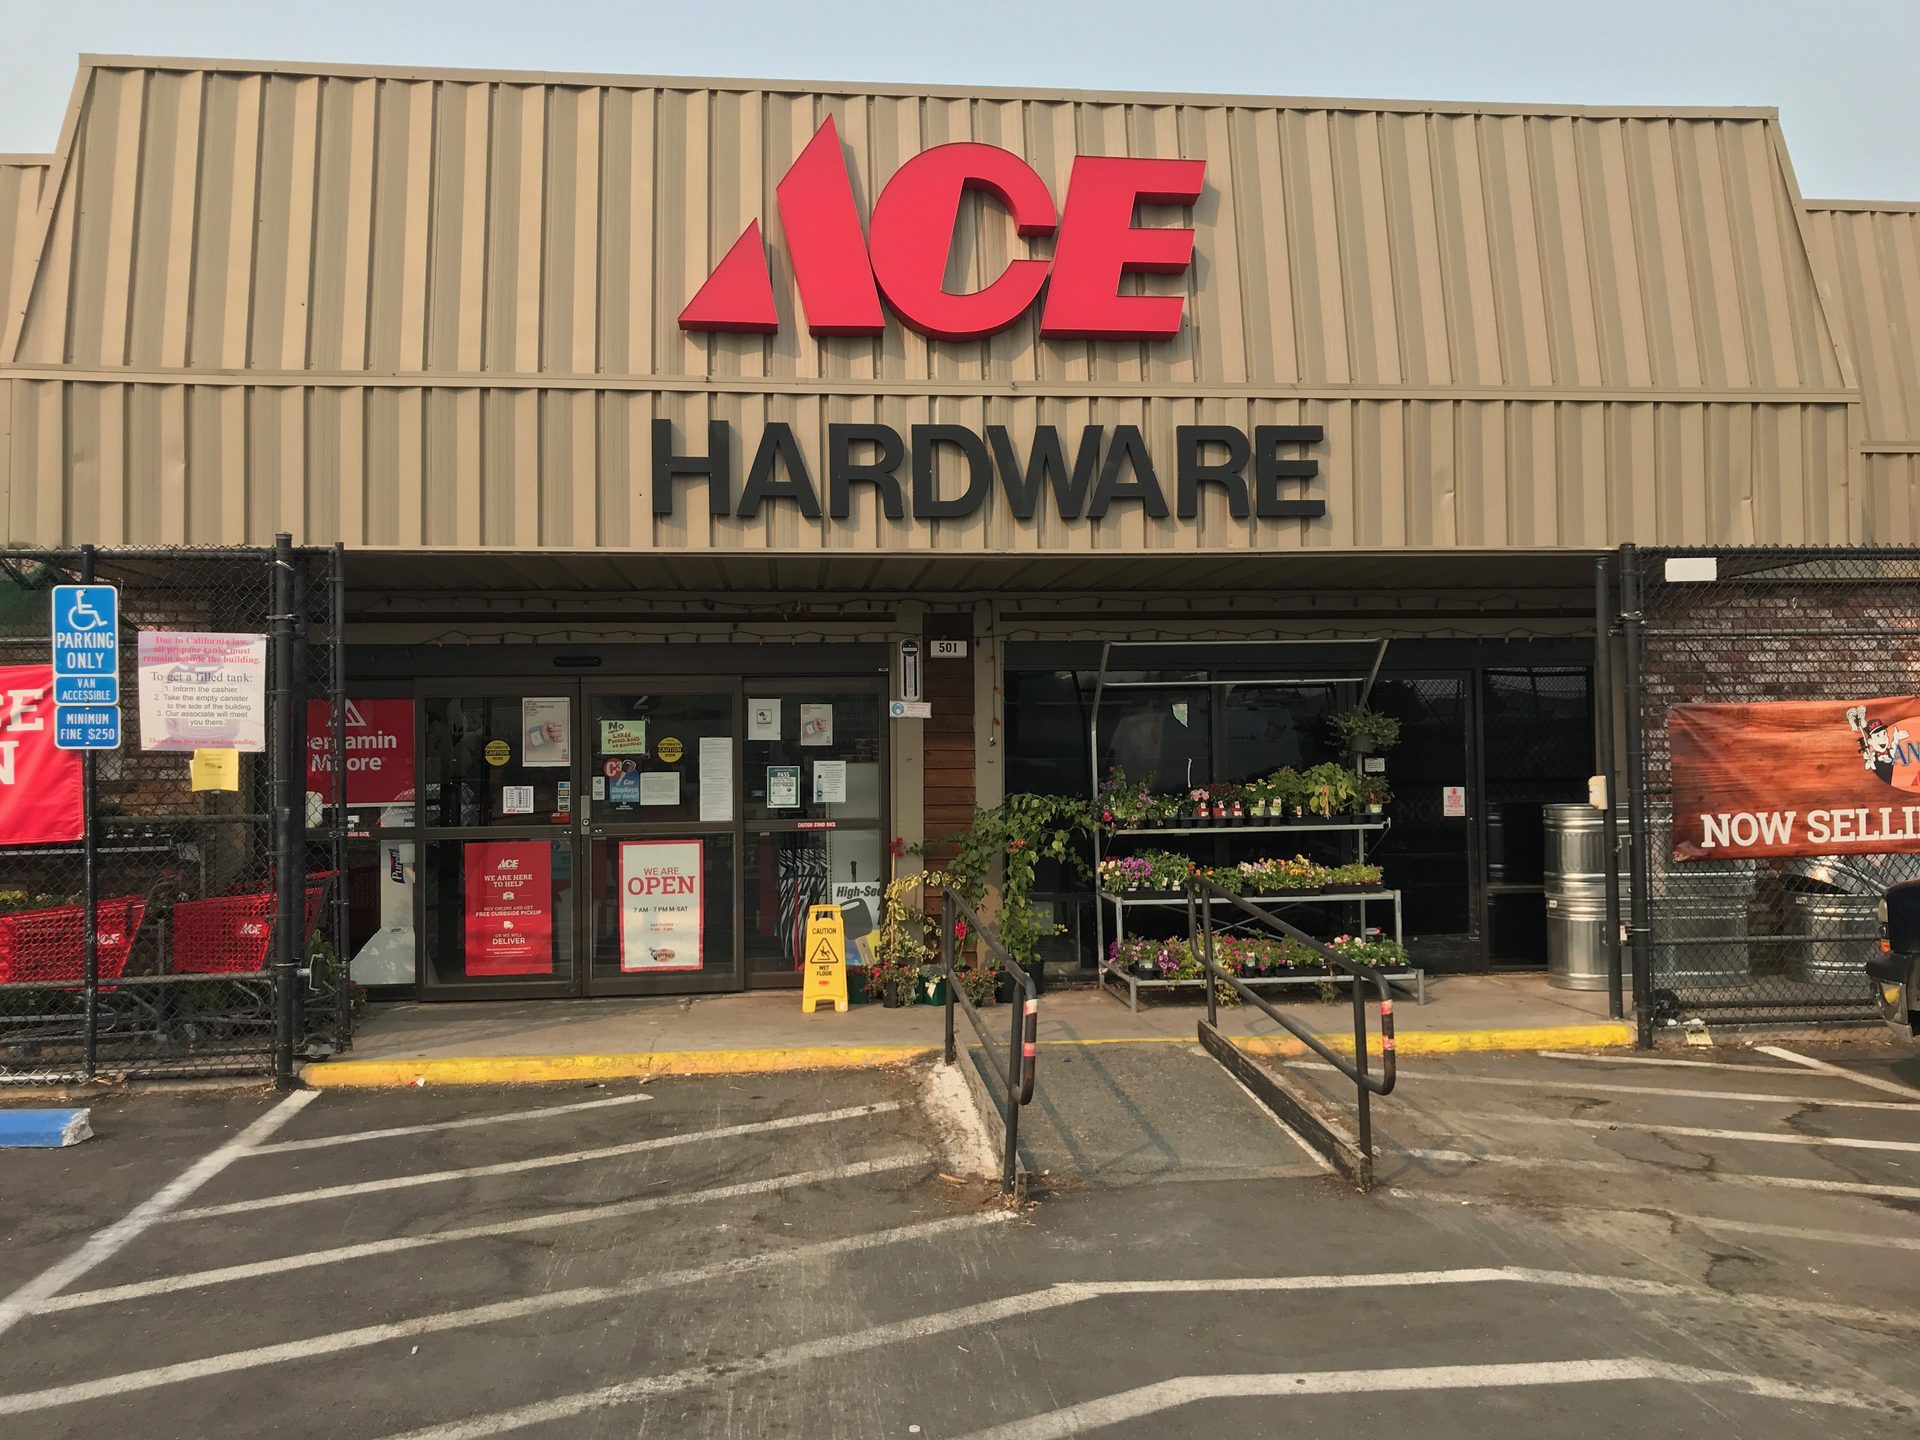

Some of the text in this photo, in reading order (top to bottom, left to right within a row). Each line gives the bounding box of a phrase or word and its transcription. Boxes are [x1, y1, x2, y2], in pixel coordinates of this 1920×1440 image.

[678, 112, 1207, 342] ACE
[651, 418, 1325, 519] HARDWARE
[57, 632, 114, 649] PARKING
[155, 636, 172, 645] Due
[174, 636, 184, 645] to
[186, 636, 229, 646] California
[153, 645, 251, 656] all propane tanks must
[938, 642, 957, 653] 501
[66, 652, 104, 669] ONLY
[175, 655, 206, 664] outside
[208, 655, 220, 663] the
[150, 672, 164, 681] To
[167, 673, 182, 684] get
[196, 671, 223, 682] filled
[227, 673, 253, 682] tank:
[77, 678, 96, 689] VAN
[173, 685, 196, 693] Inform
[198, 685, 210, 693] the
[62, 690, 111, 701] ACCESSIBLE
[195, 694, 218, 702] empty
[220, 694, 249, 702] canister
[188, 702, 203, 710] side
[212, 702, 223, 710] the
[66, 713, 109, 725] MINIMUM
[608, 721, 625, 731] No
[60, 728, 115, 741] FINE $250
[1701, 806, 1920, 848] NOW SELLI
[497, 858, 519, 869] ACE
[643, 866, 680, 876] WE ARE
[627, 875, 696, 896] OPEN
[240, 922, 263, 935] ACE
[812, 927, 837, 935] CAUTION
[492, 937, 526, 945] DELIVER
